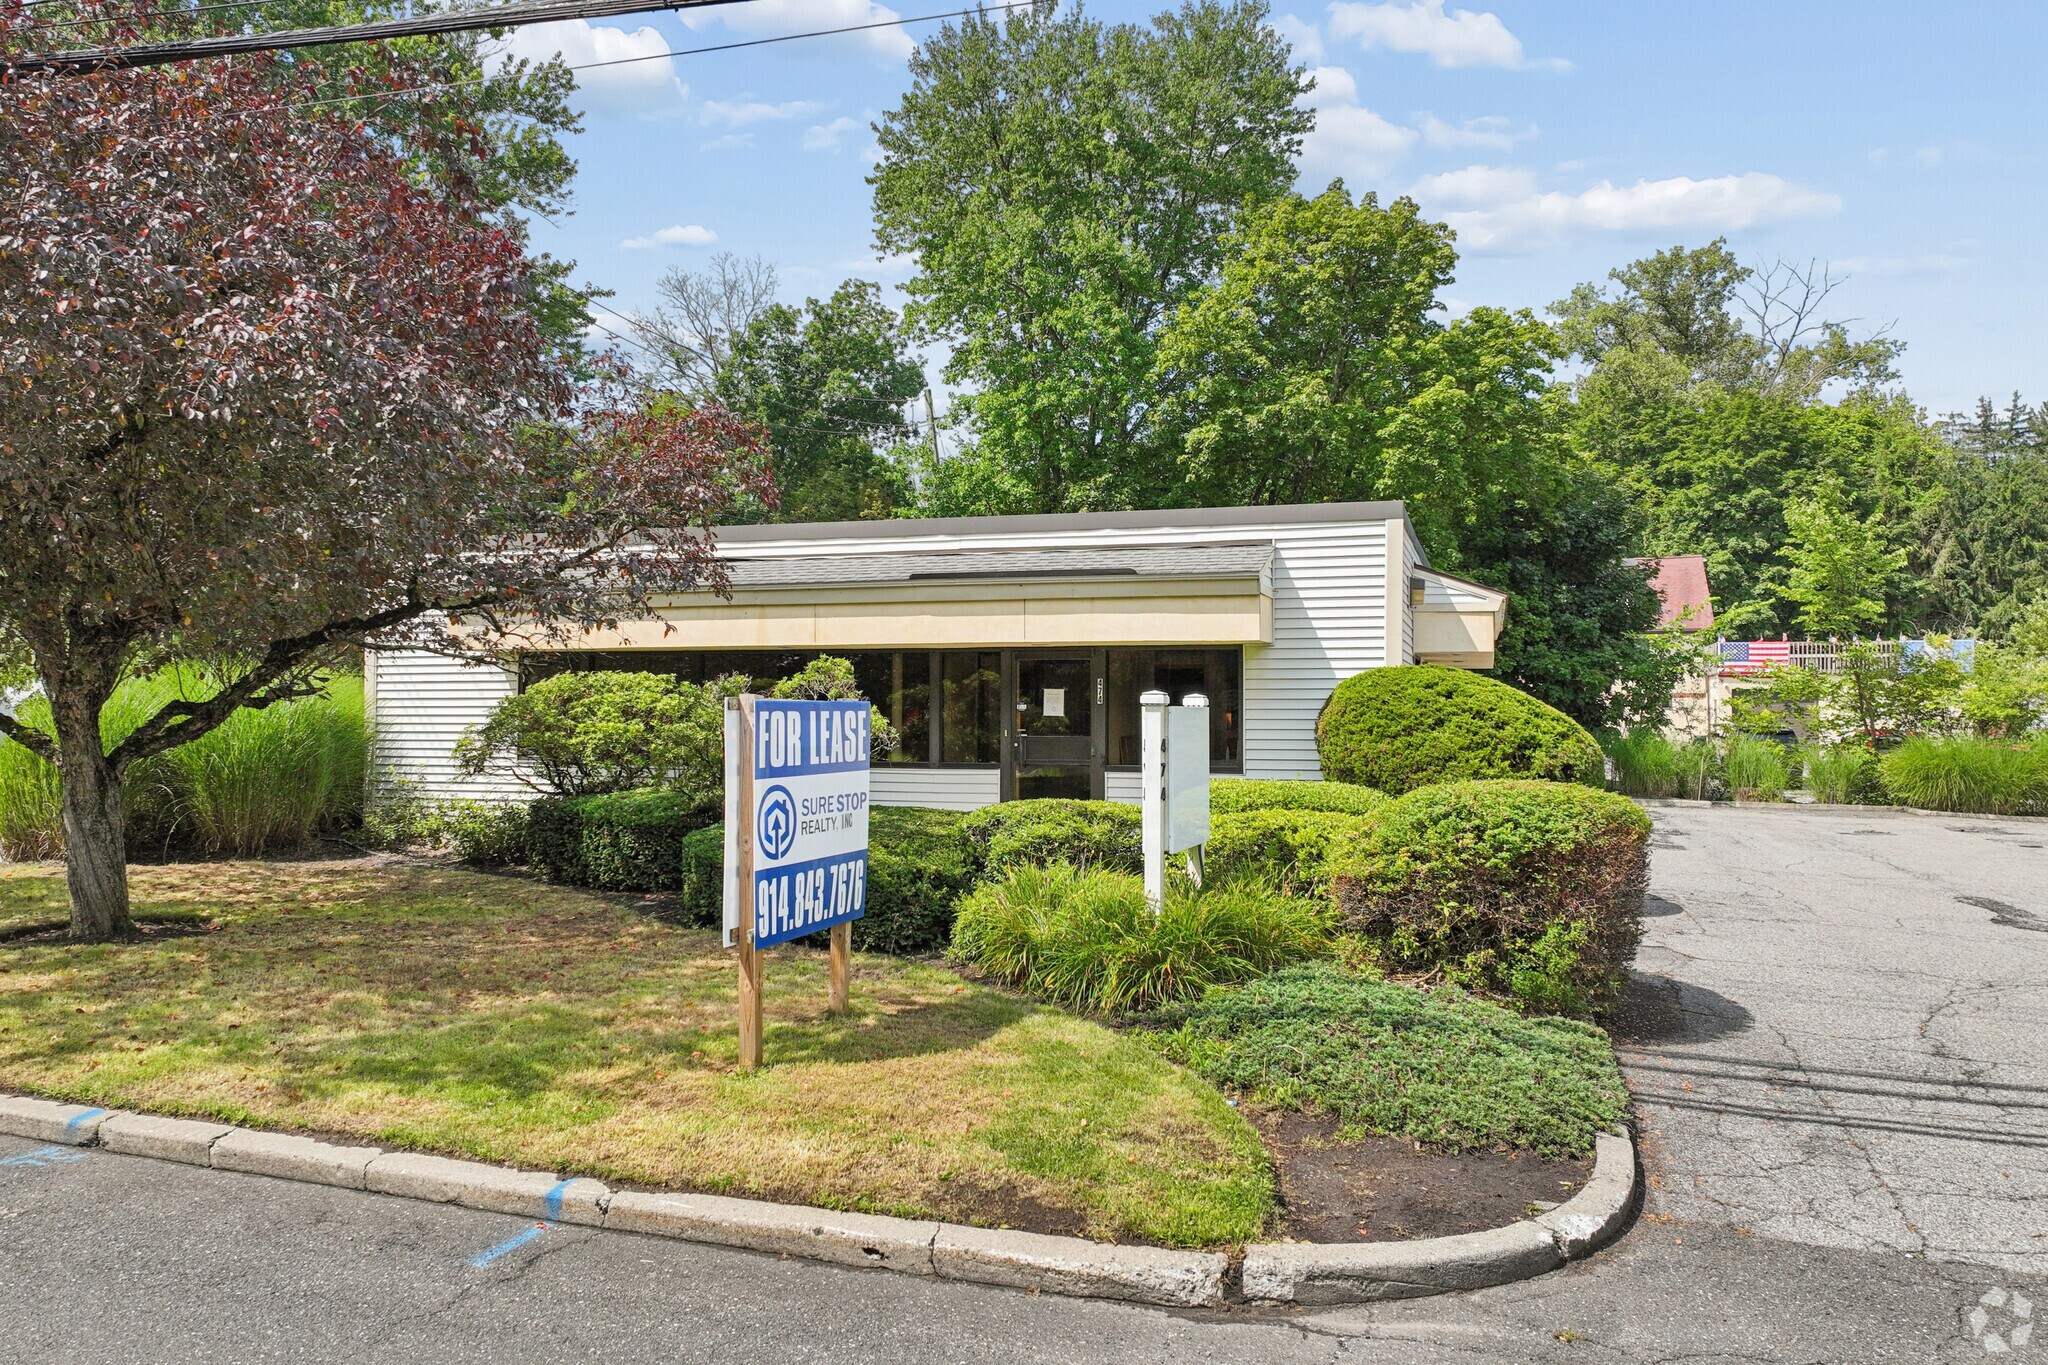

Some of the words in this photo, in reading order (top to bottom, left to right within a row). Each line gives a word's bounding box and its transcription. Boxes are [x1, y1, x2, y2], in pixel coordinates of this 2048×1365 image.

[759, 711, 801, 768] FOR
[809, 710, 867, 765] LEASE
[801, 796, 835, 817] SURE
[836, 792, 867, 813] STOP
[841, 813, 853, 830] INC
[758, 859, 864, 939] 914.843.7676
